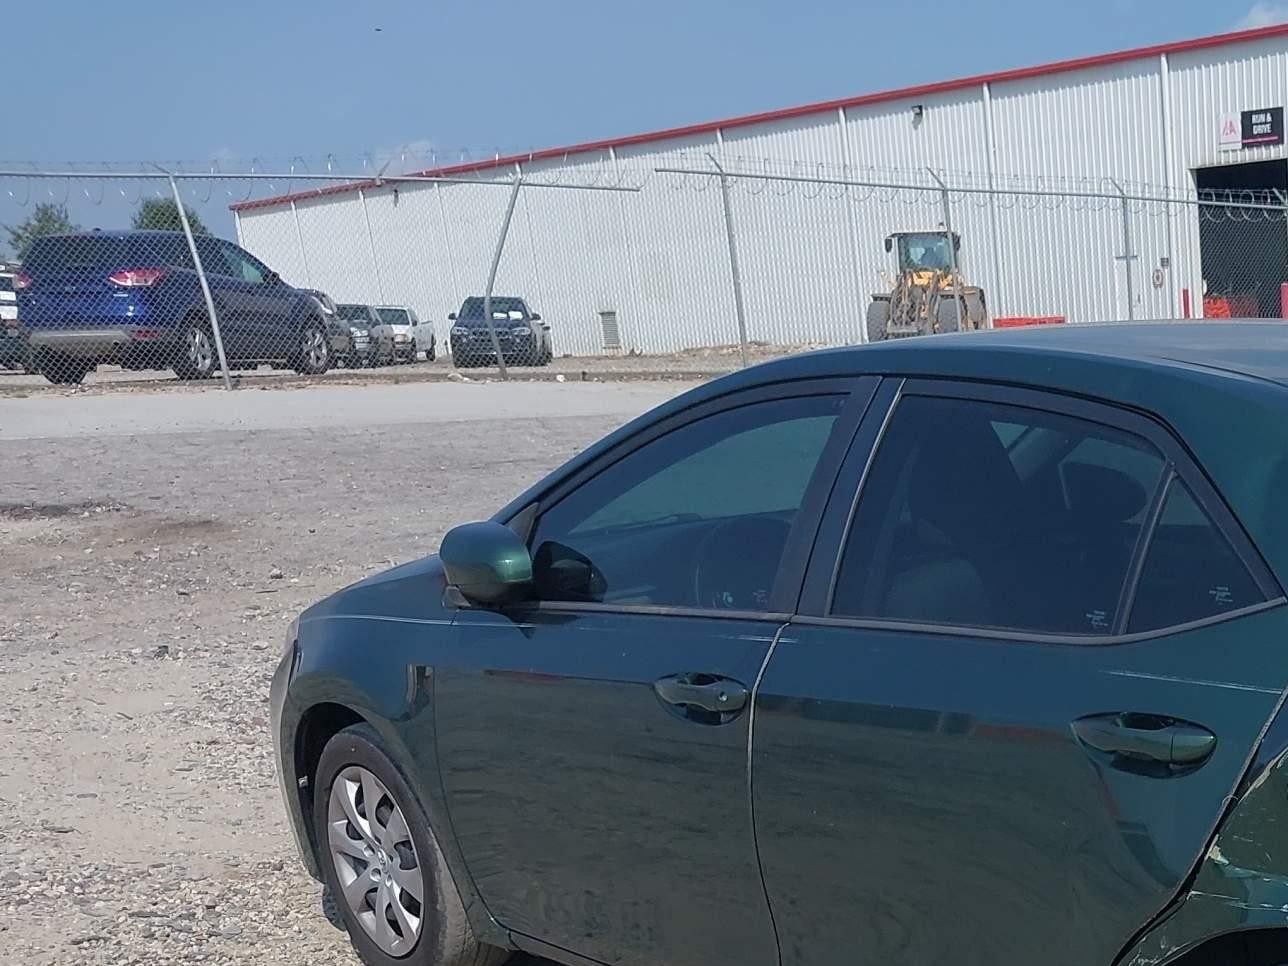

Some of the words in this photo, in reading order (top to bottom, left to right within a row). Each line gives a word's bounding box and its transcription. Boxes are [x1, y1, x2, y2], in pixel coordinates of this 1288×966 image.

[1251, 113, 1266, 124] RUN
[1266, 112, 1272, 122] &
[1252, 123, 1272, 135] DRIVE
